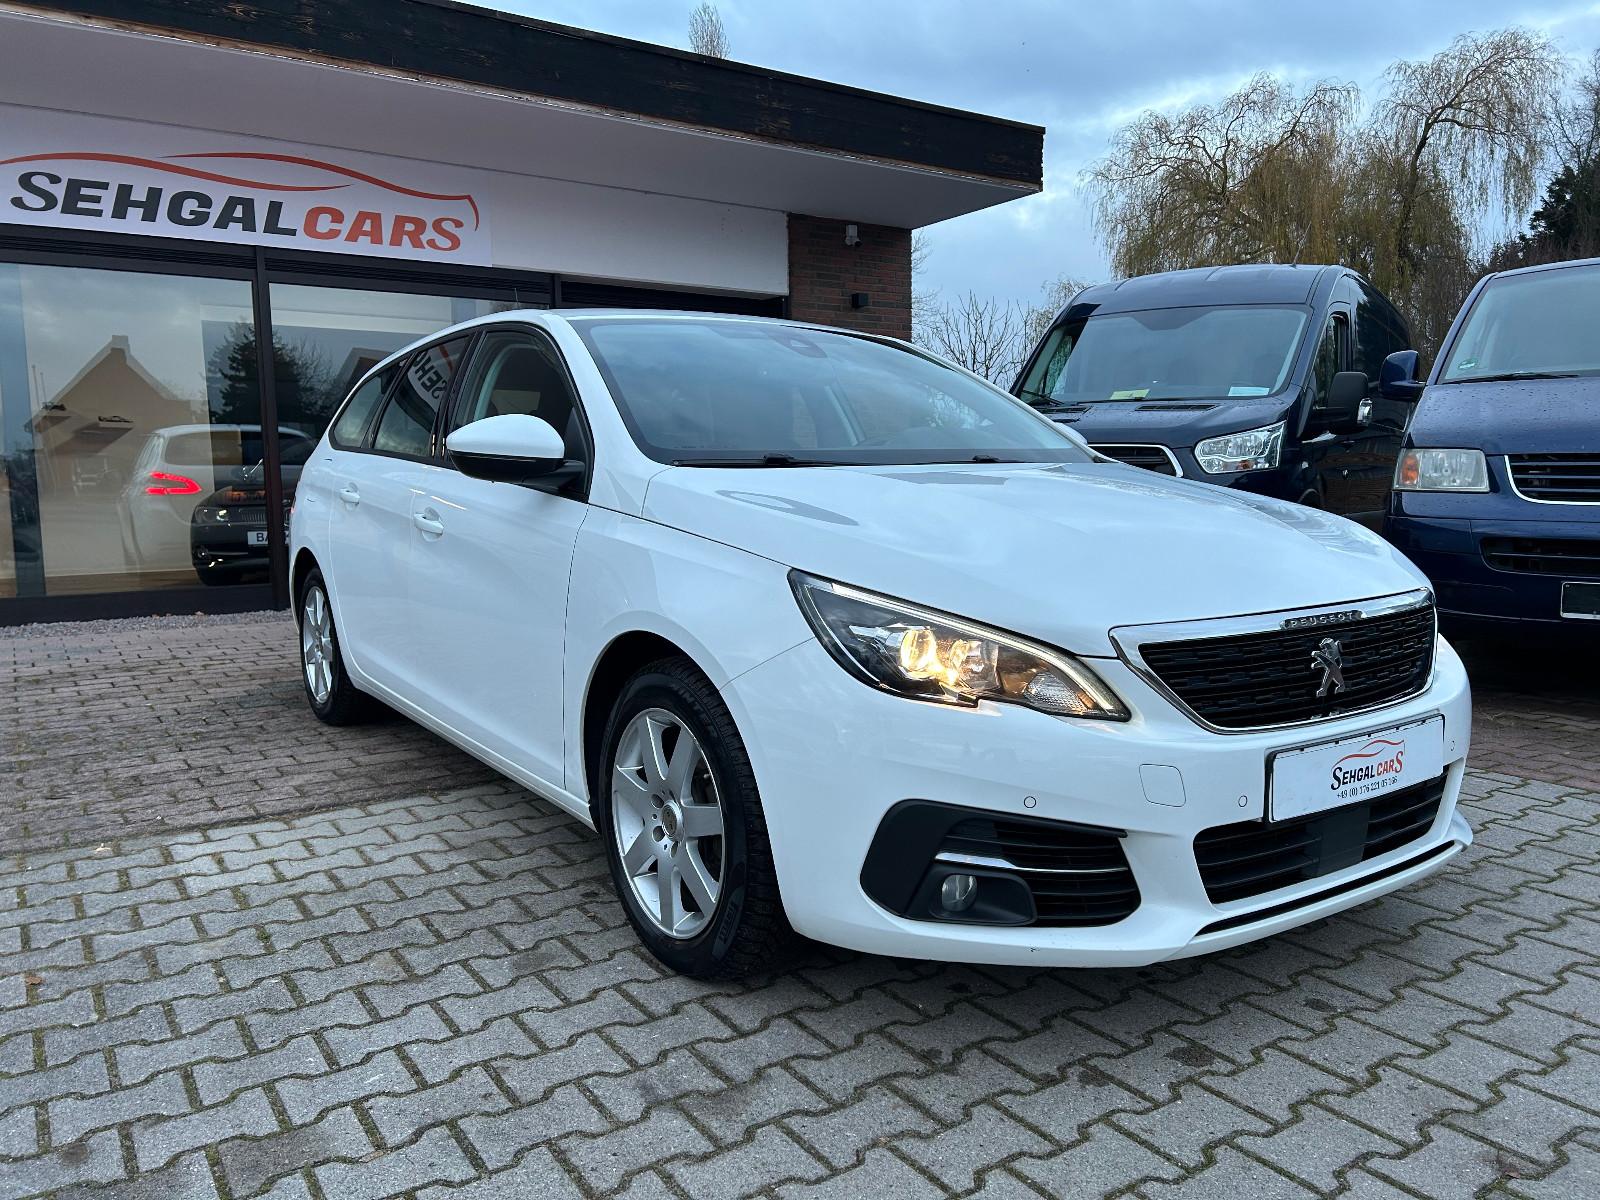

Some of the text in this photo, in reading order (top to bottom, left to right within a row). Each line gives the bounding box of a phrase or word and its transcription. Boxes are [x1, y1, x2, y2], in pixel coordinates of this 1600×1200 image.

[1290, 612, 1353, 628] PEUGEOT
[1331, 751, 1404, 790] SEHGAL CARS
